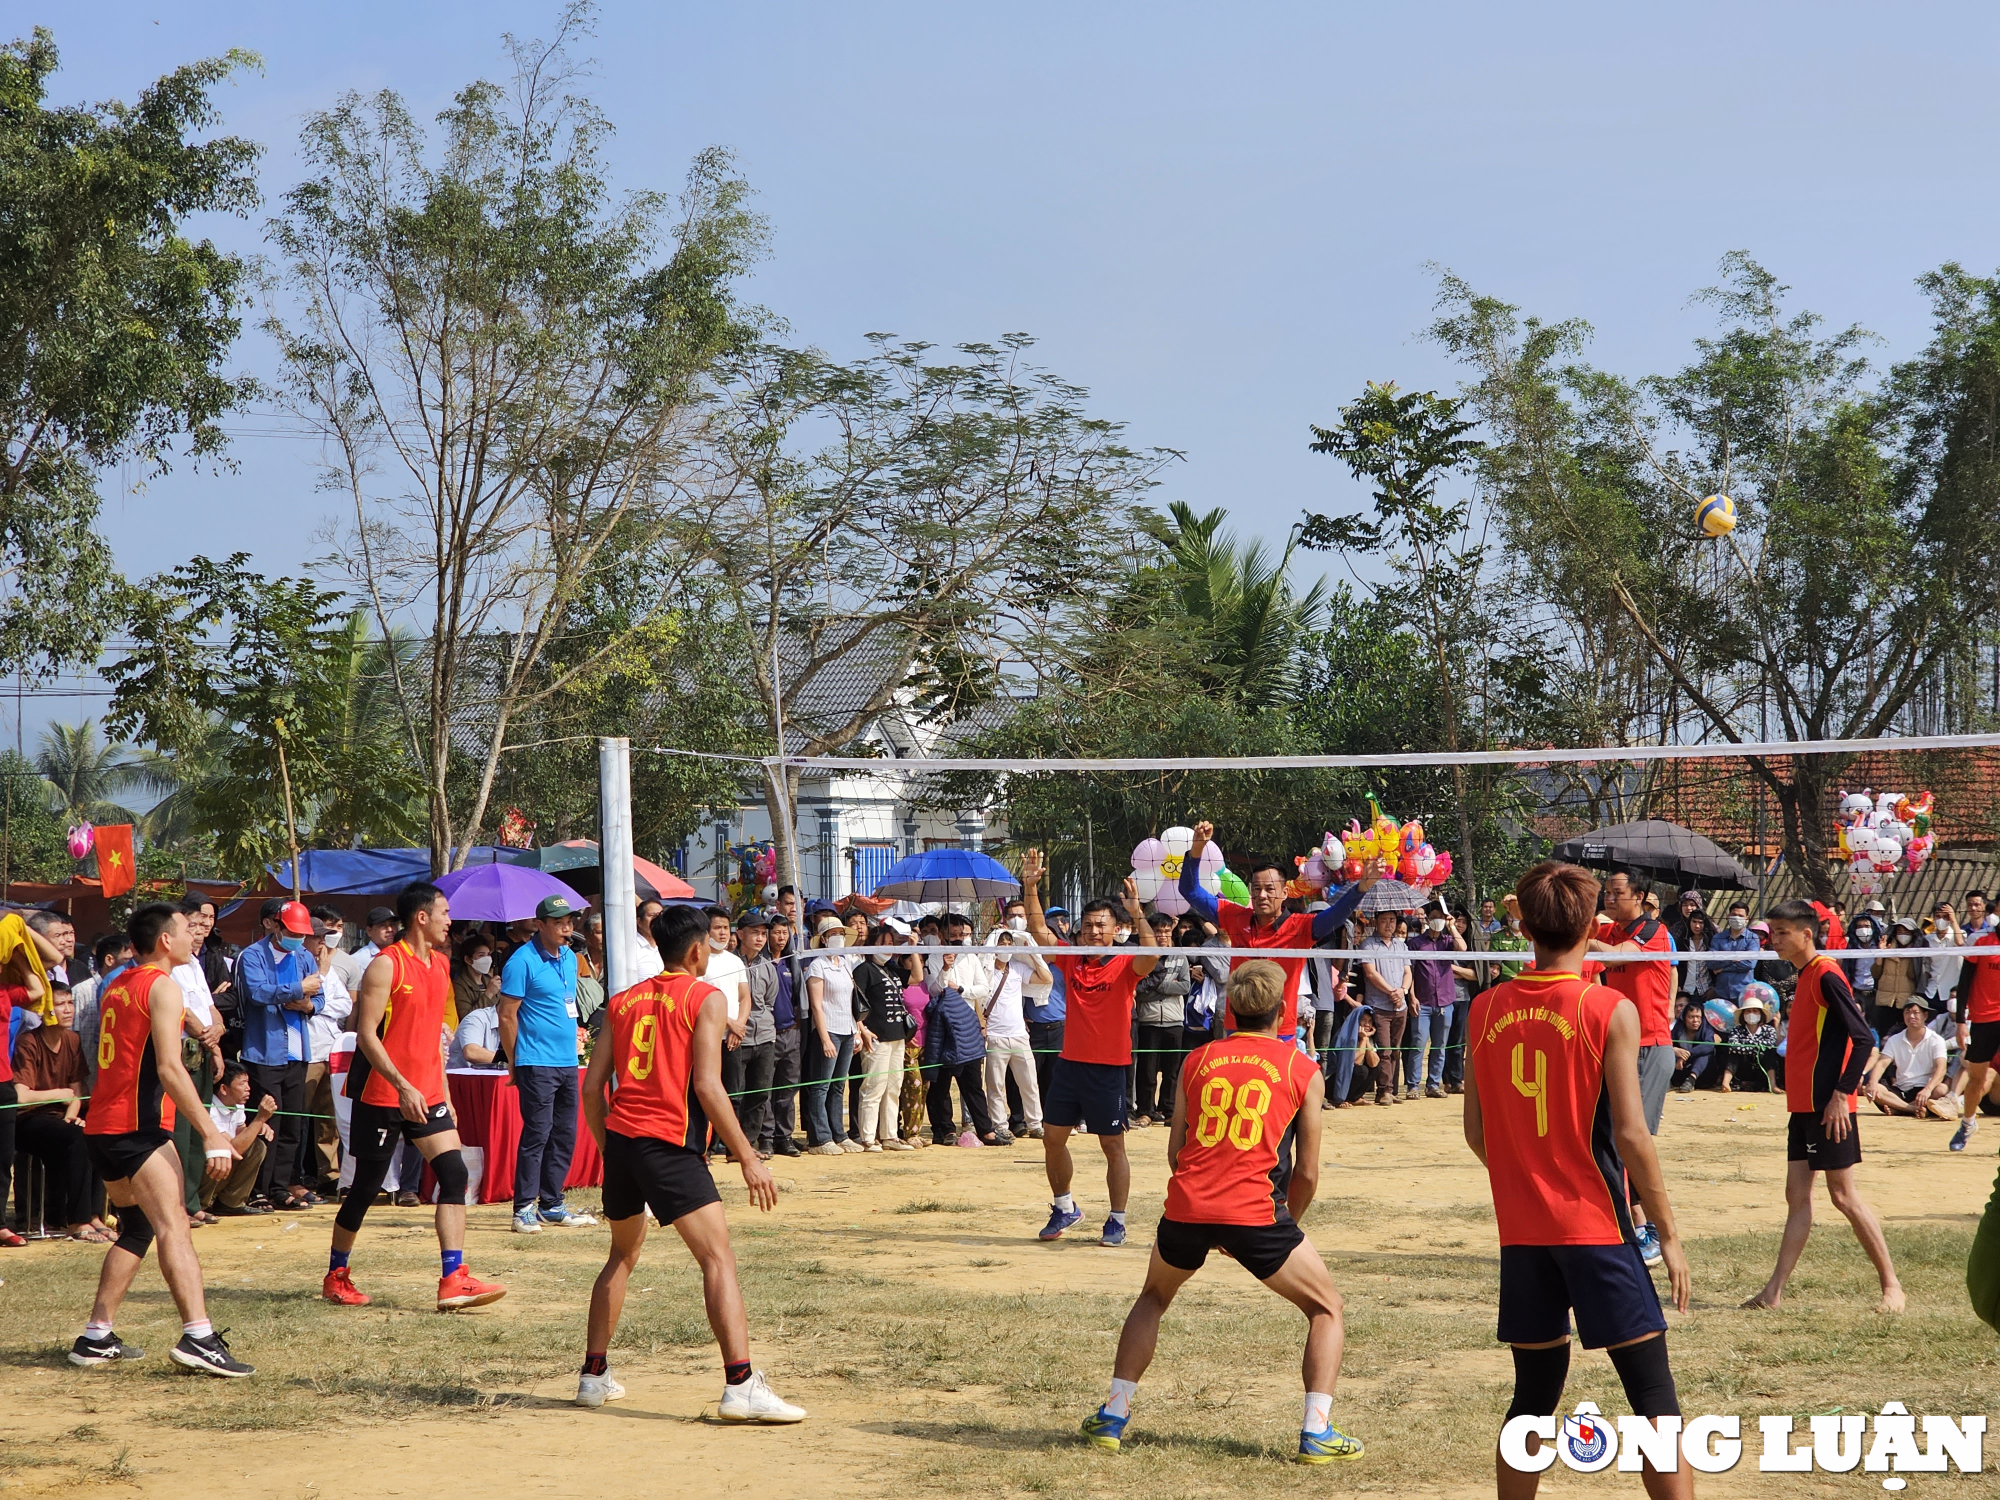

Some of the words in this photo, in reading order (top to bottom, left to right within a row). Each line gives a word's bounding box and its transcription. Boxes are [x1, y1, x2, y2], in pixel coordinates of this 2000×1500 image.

[97, 1007, 116, 1070] 6
[628, 1014, 657, 1080] 9
[1494, 1011, 1515, 1033] QUAN
[1208, 1055, 1230, 1070] QUAN
[1511, 1042, 1548, 1137] 4
[377, 1127, 389, 1147] 7
[1195, 1076, 1272, 1152] 88
